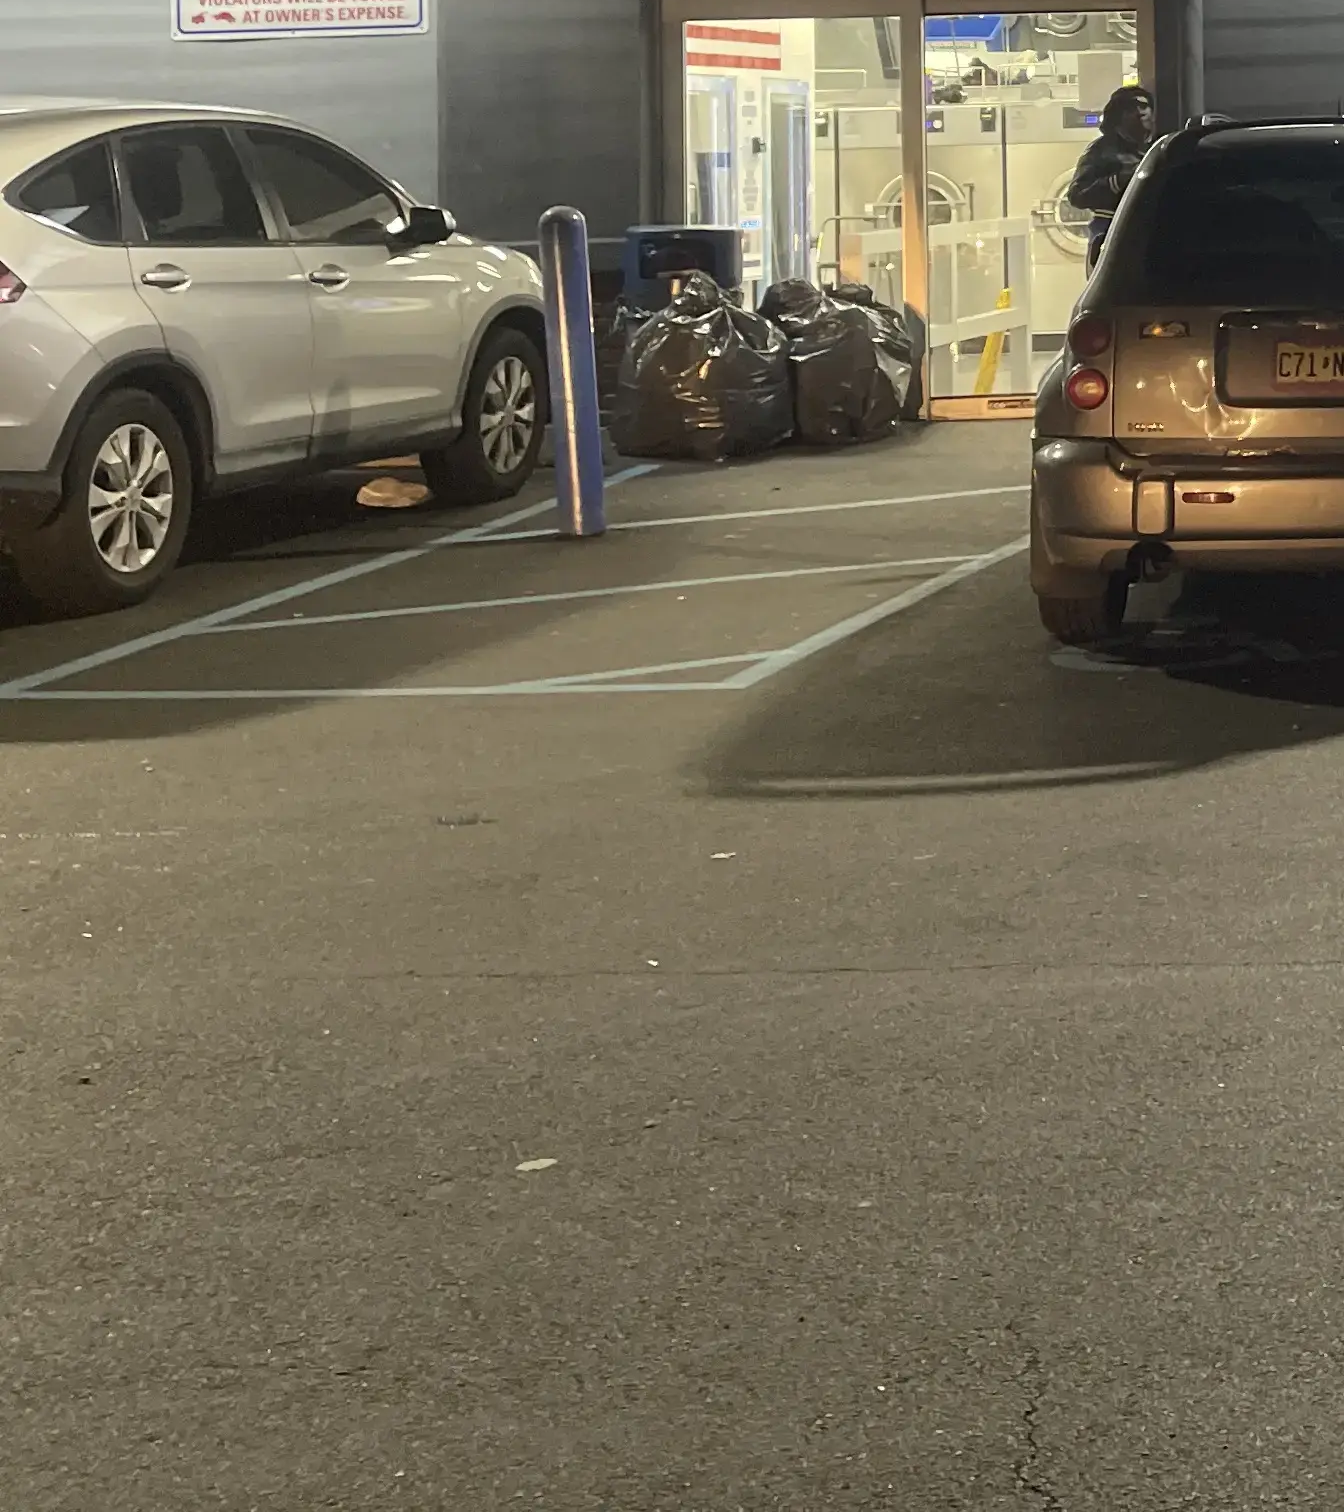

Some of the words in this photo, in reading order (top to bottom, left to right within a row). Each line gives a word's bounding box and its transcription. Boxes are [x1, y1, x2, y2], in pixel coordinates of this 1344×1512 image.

[242, 10, 260, 24] AT
[265, 8, 335, 22] OWNER'S
[339, 6, 405, 21] EXPENSE
